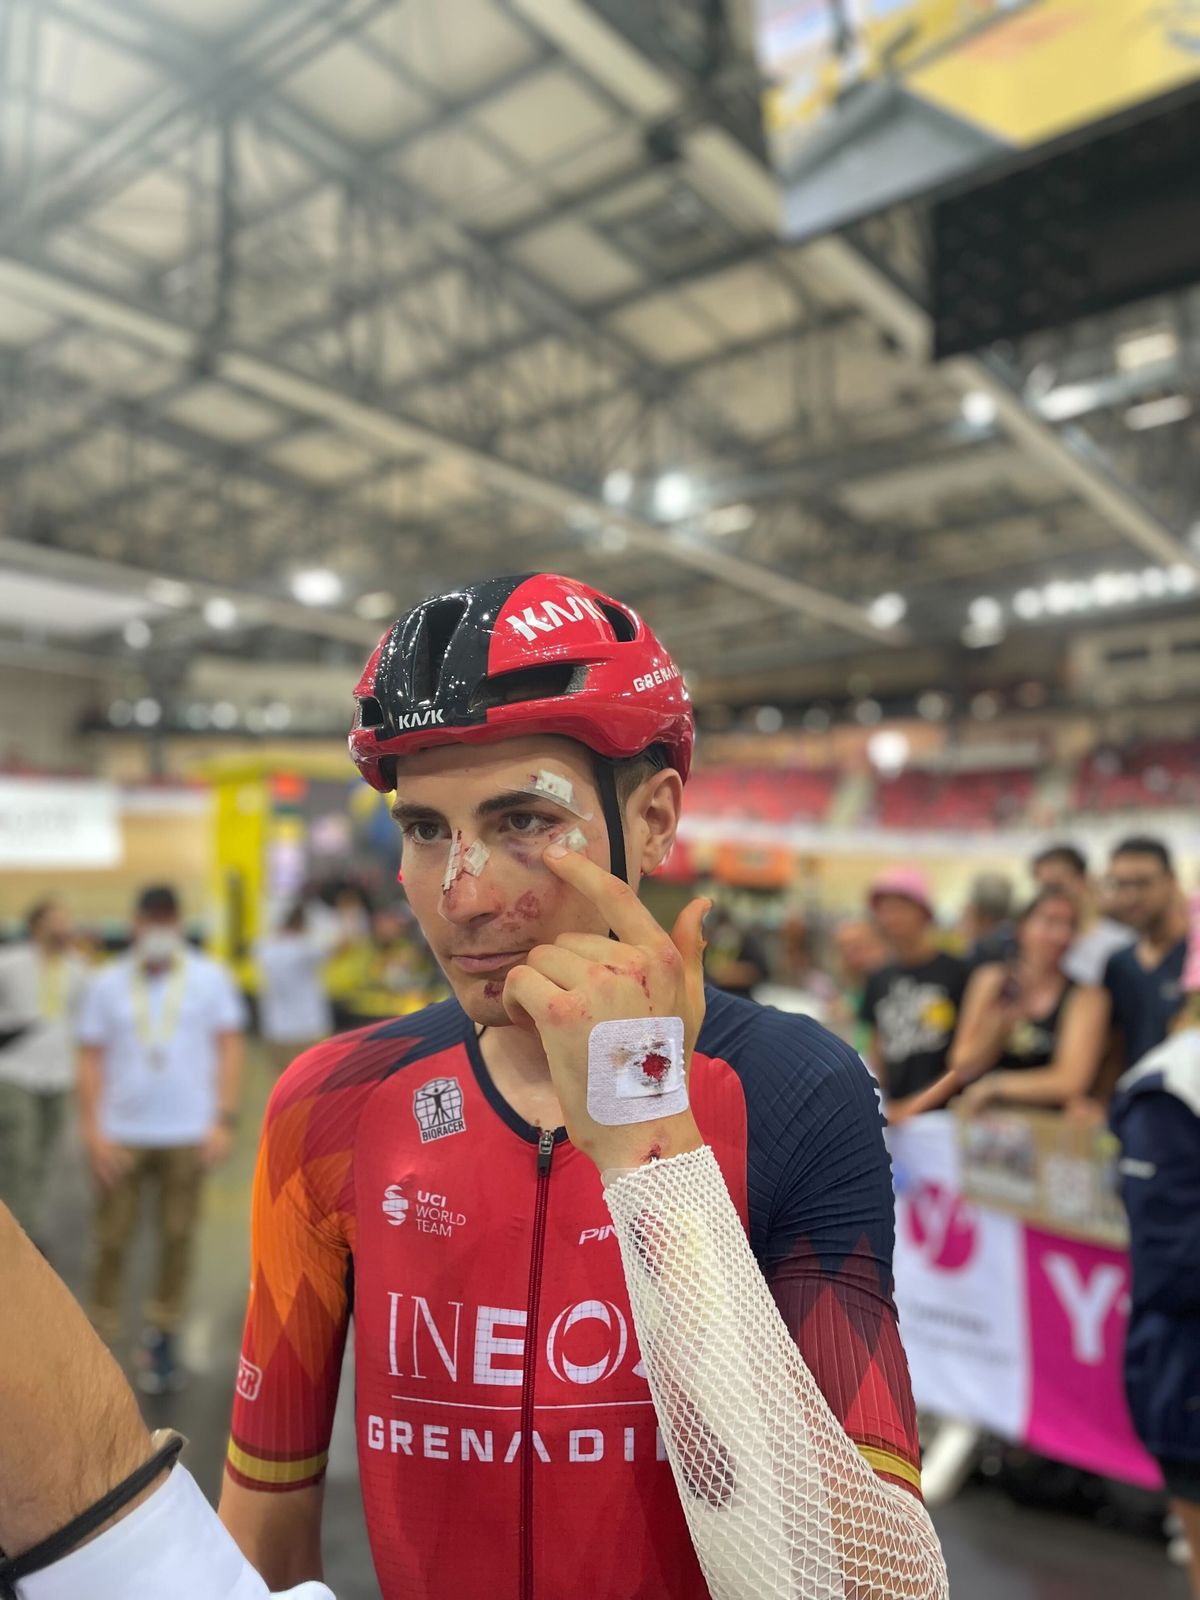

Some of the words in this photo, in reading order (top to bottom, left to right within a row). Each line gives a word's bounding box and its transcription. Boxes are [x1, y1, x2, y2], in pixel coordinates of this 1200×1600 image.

[505, 595, 609, 641] KASK
[398, 708, 444, 729] KASK
[422, 1120, 464, 1141] BIORACER
[417, 1190, 446, 1207] UCI
[415, 1204, 466, 1226] WORLD
[415, 1218, 452, 1237] TEAM
[387, 1291, 648, 1386] INEO
